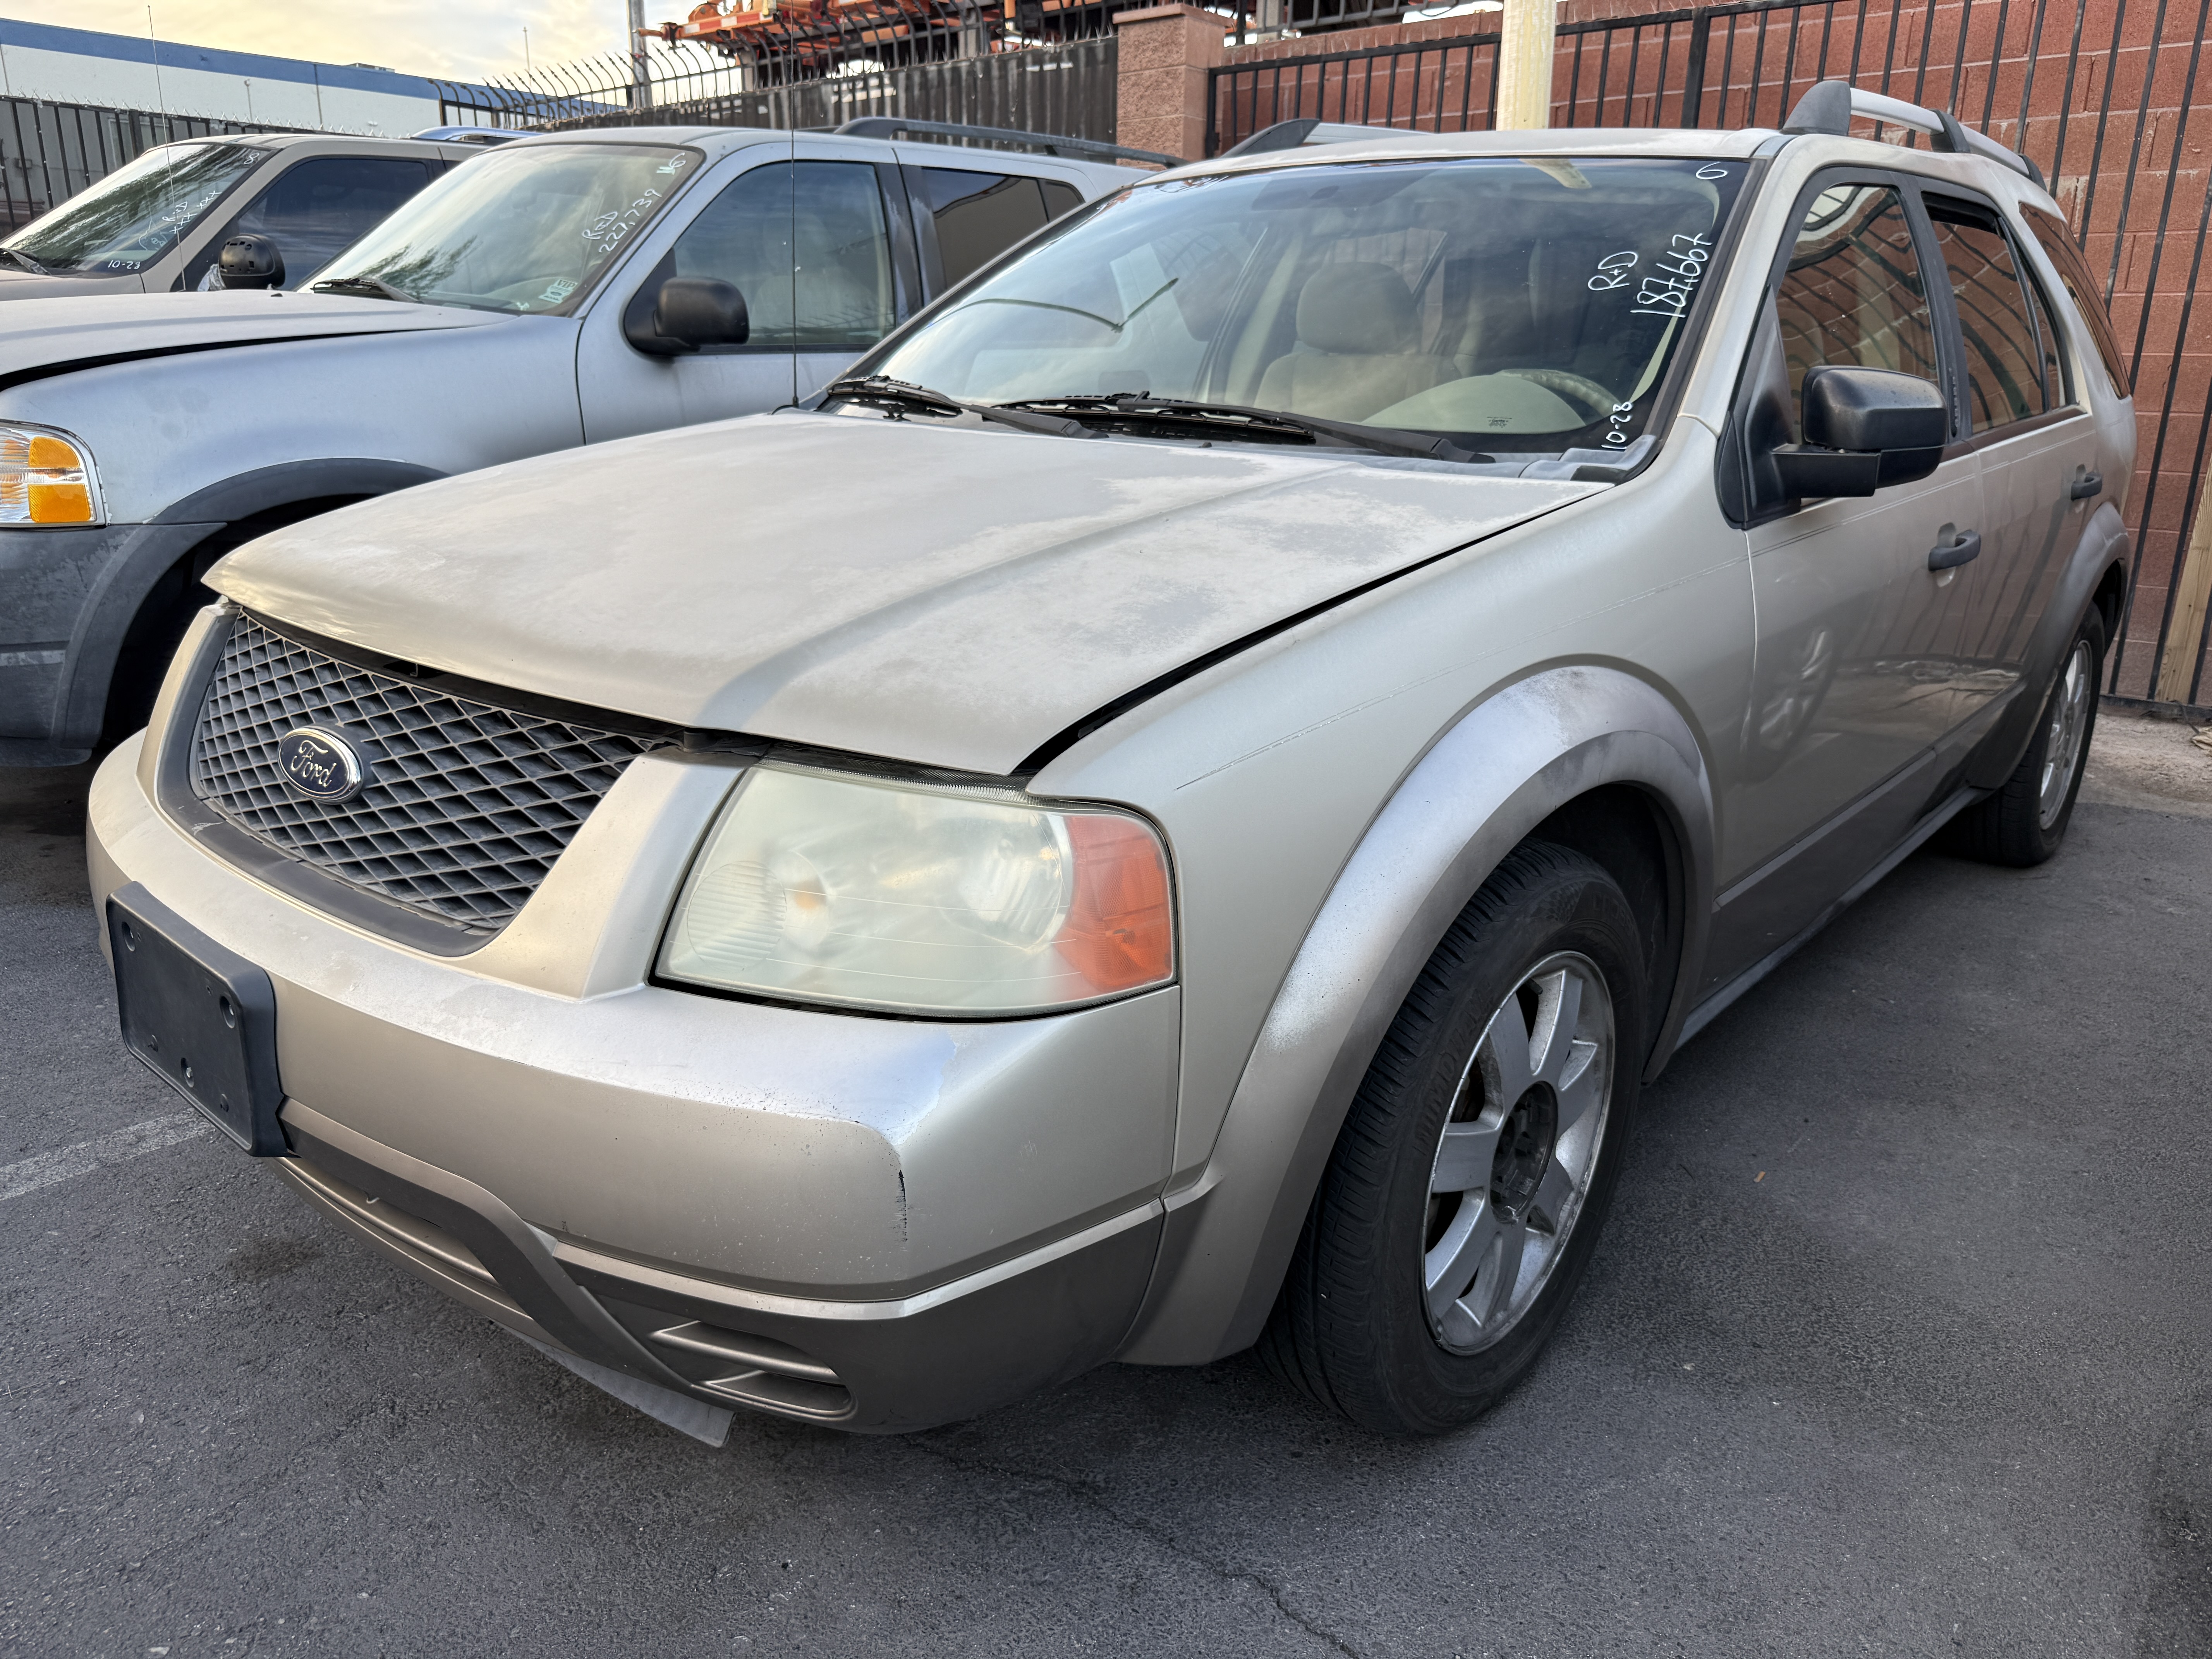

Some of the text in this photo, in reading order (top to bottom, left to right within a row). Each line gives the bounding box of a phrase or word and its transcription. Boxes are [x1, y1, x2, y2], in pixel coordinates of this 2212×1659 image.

[108, 260, 140, 270] 10-28
[1630, 233, 1712, 318] 187,667
[1601, 402, 1632, 450] 10-28
[291, 740, 337, 787] Ford
